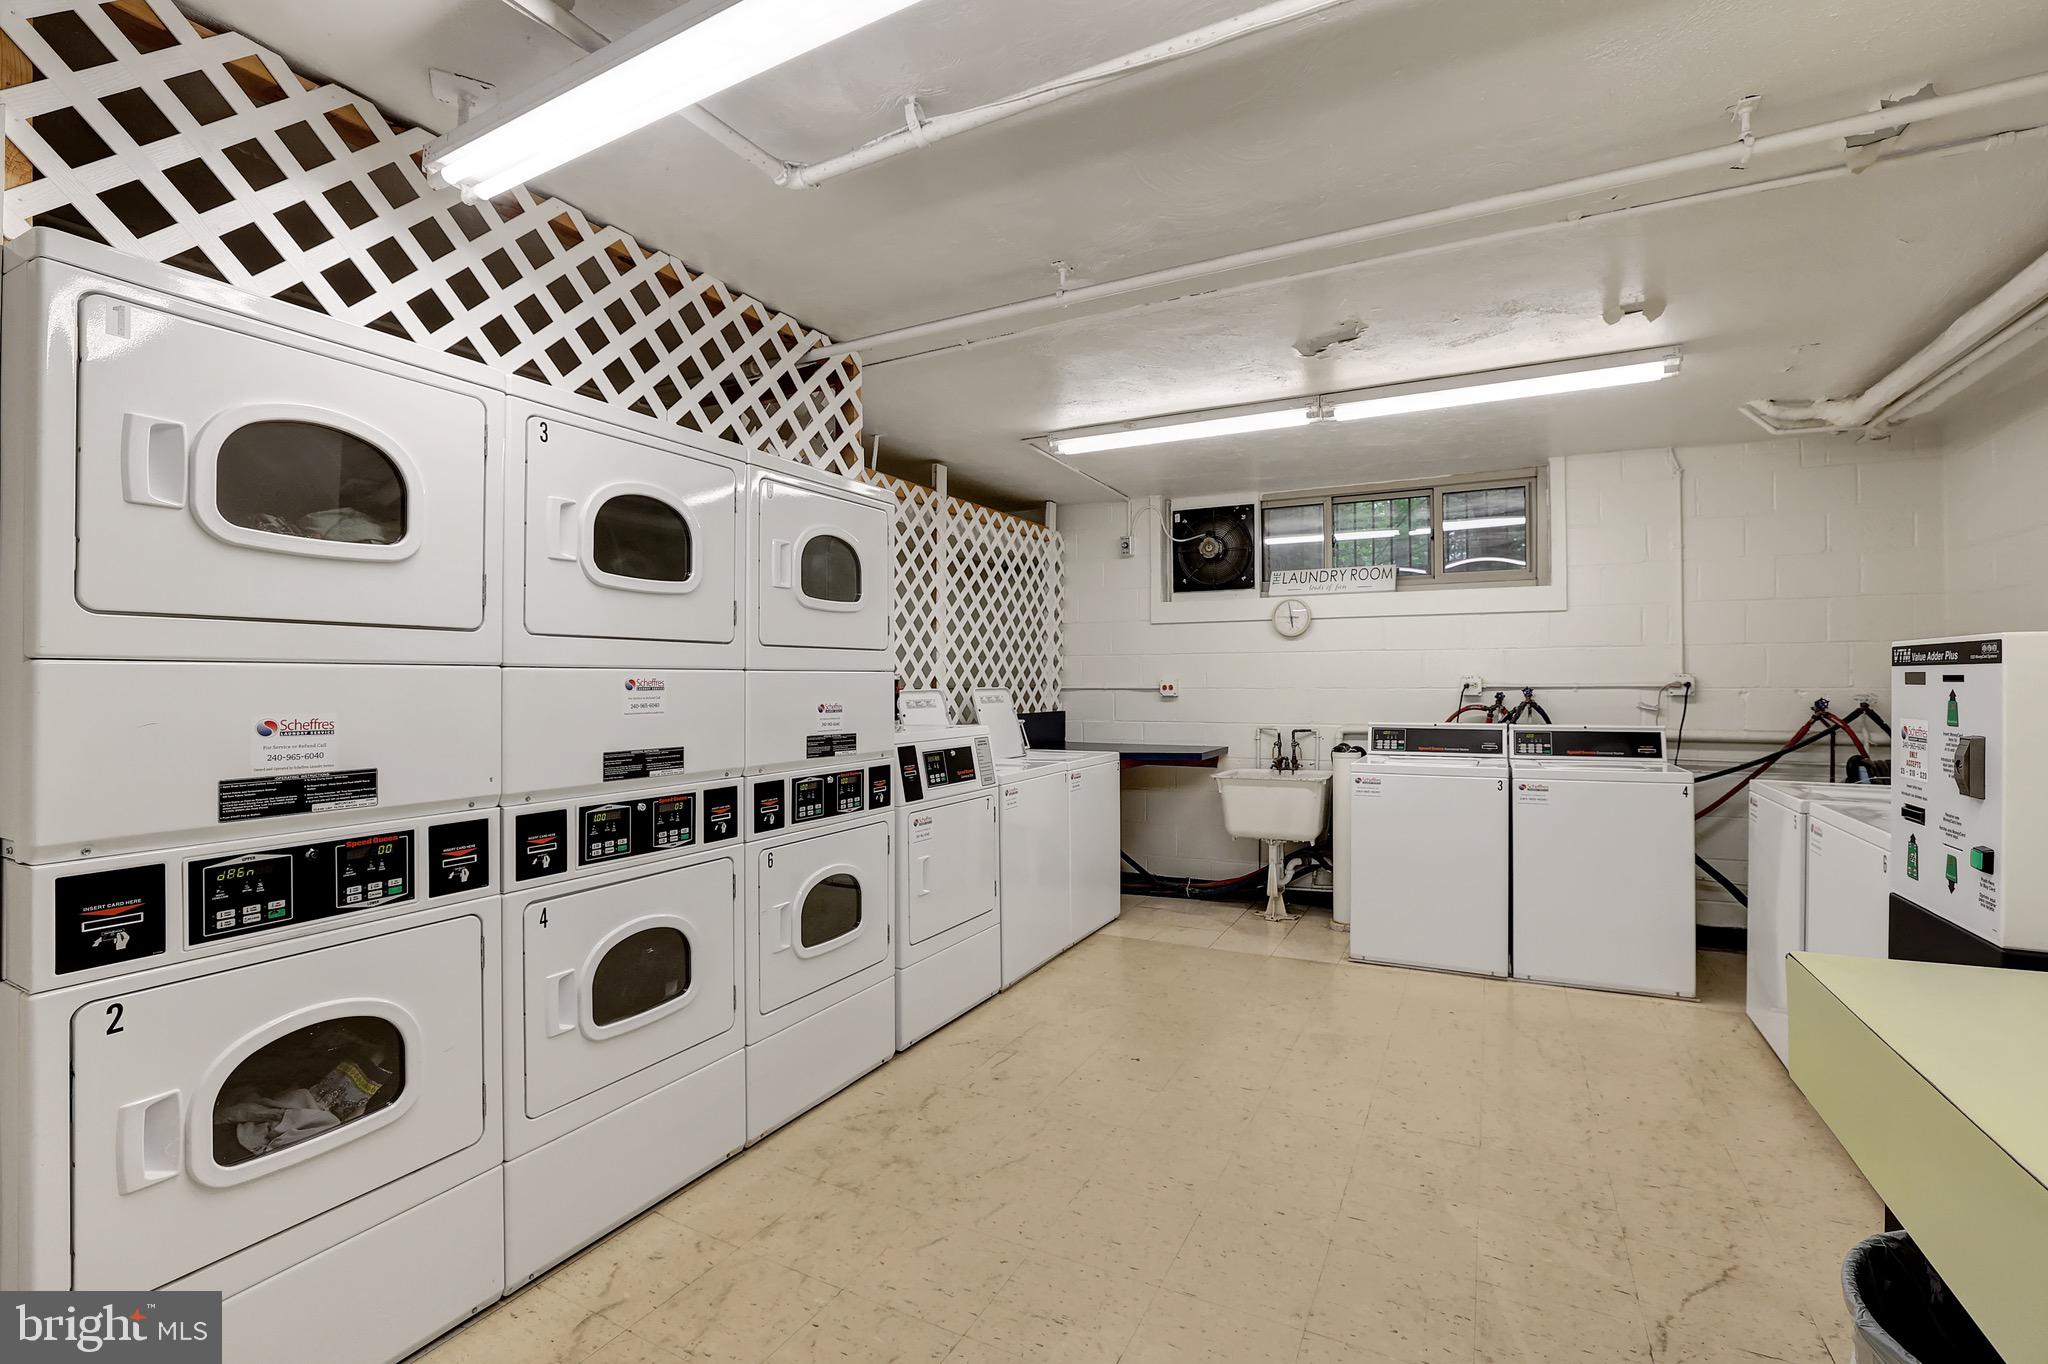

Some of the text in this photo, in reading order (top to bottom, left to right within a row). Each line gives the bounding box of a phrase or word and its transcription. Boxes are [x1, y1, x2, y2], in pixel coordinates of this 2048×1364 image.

[540, 422, 548, 442] 3
[1272, 567, 1393, 585] THE LAUNDRY ROOM
[1893, 648, 1959, 663] VTM Value Adder Plus
[636, 678, 665, 687] Scheffres
[280, 718, 335, 731] Scheffres
[267, 752, 325, 761] 240-965-6040
[1497, 780, 1503, 791] 3
[1682, 786, 1688, 797] 4
[346, 835, 399, 847] Speed Queen
[378, 844, 393, 855] 00
[768, 852, 773, 868] 6
[82, 903, 106, 912] INSERT
[125, 898, 142, 906] HERE
[540, 907, 548, 928] 4
[106, 1003, 123, 1035] 2
